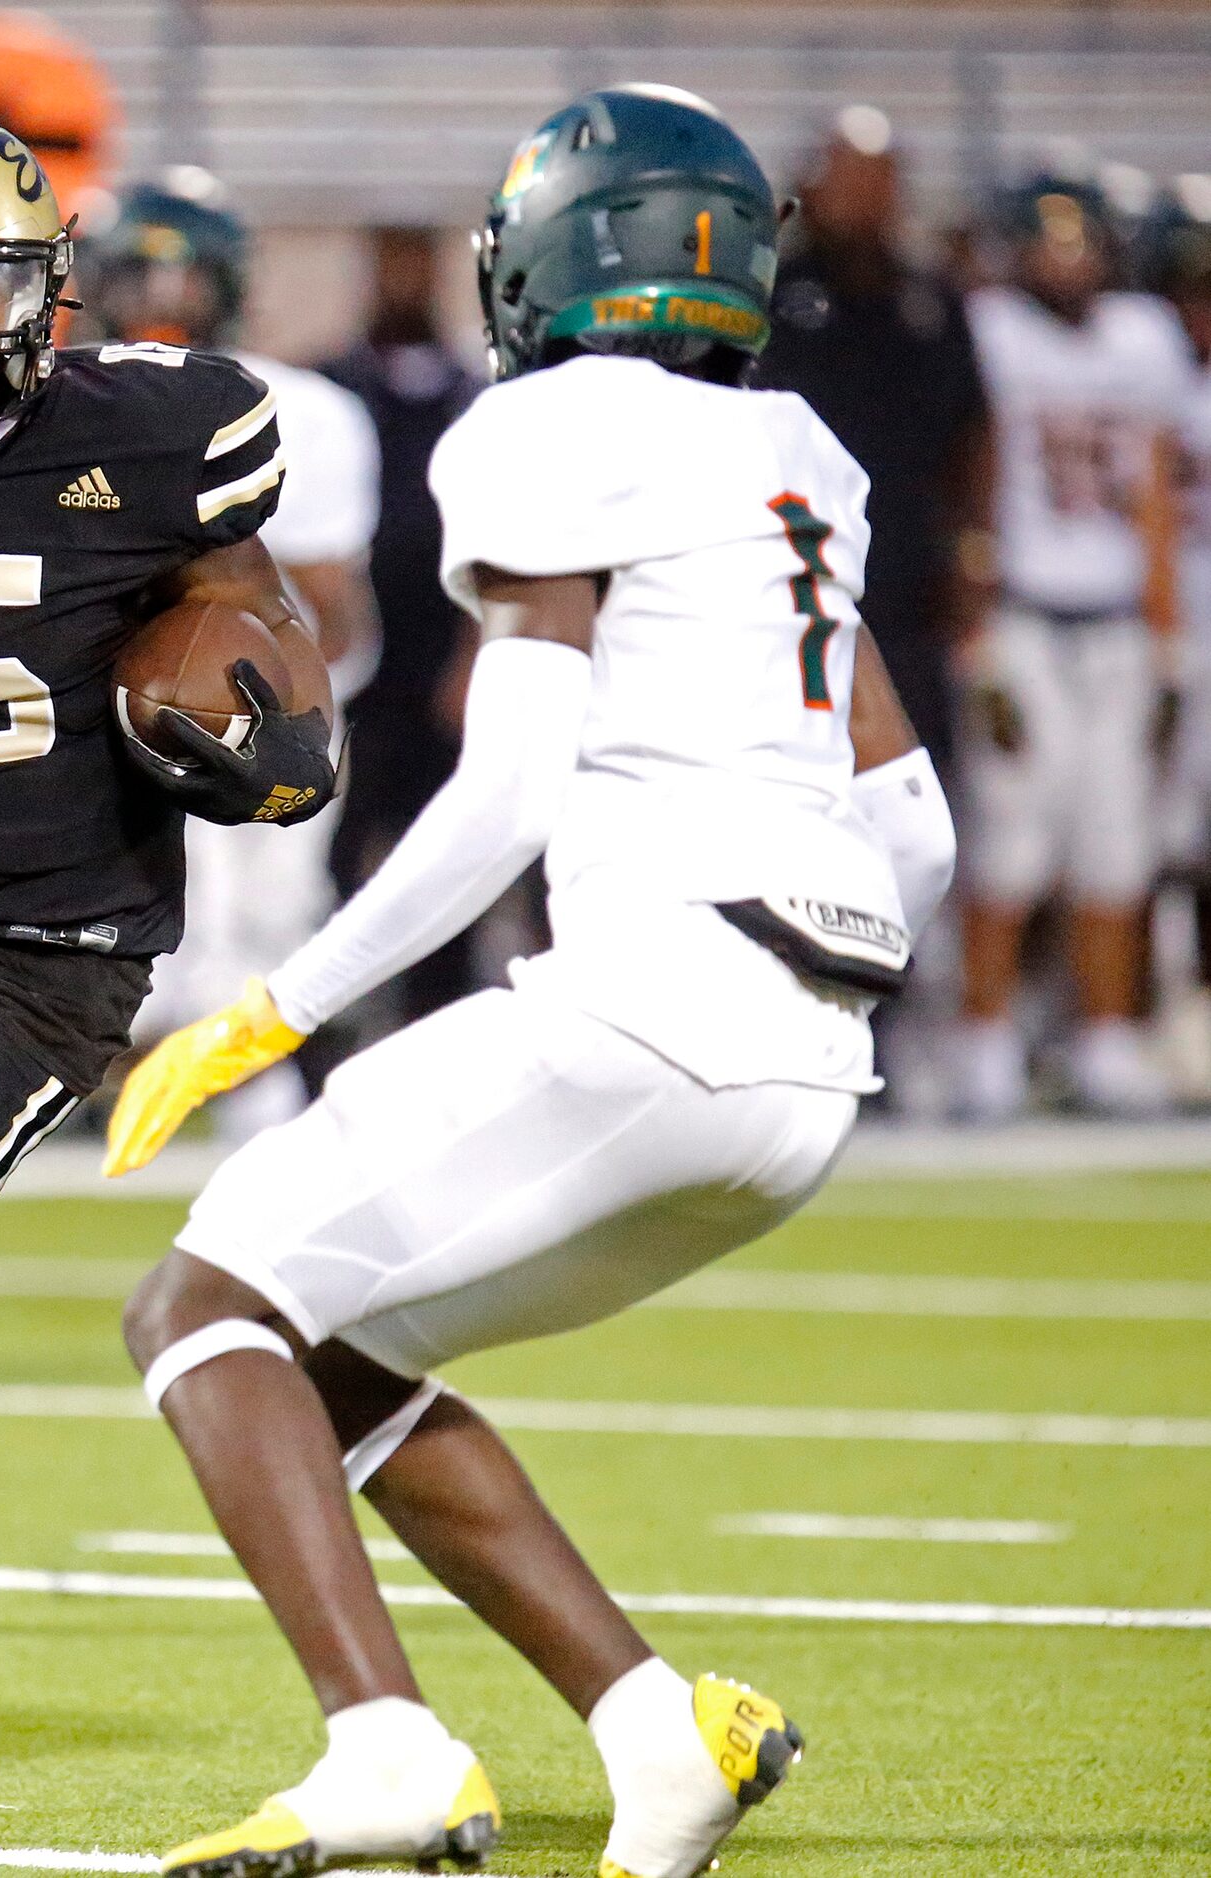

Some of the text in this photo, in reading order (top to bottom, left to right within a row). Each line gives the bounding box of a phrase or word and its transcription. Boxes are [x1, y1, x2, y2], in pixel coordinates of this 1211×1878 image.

[694, 210, 712, 274] 1
[58, 491, 121, 509] adidas
[768, 490, 839, 711] 1
